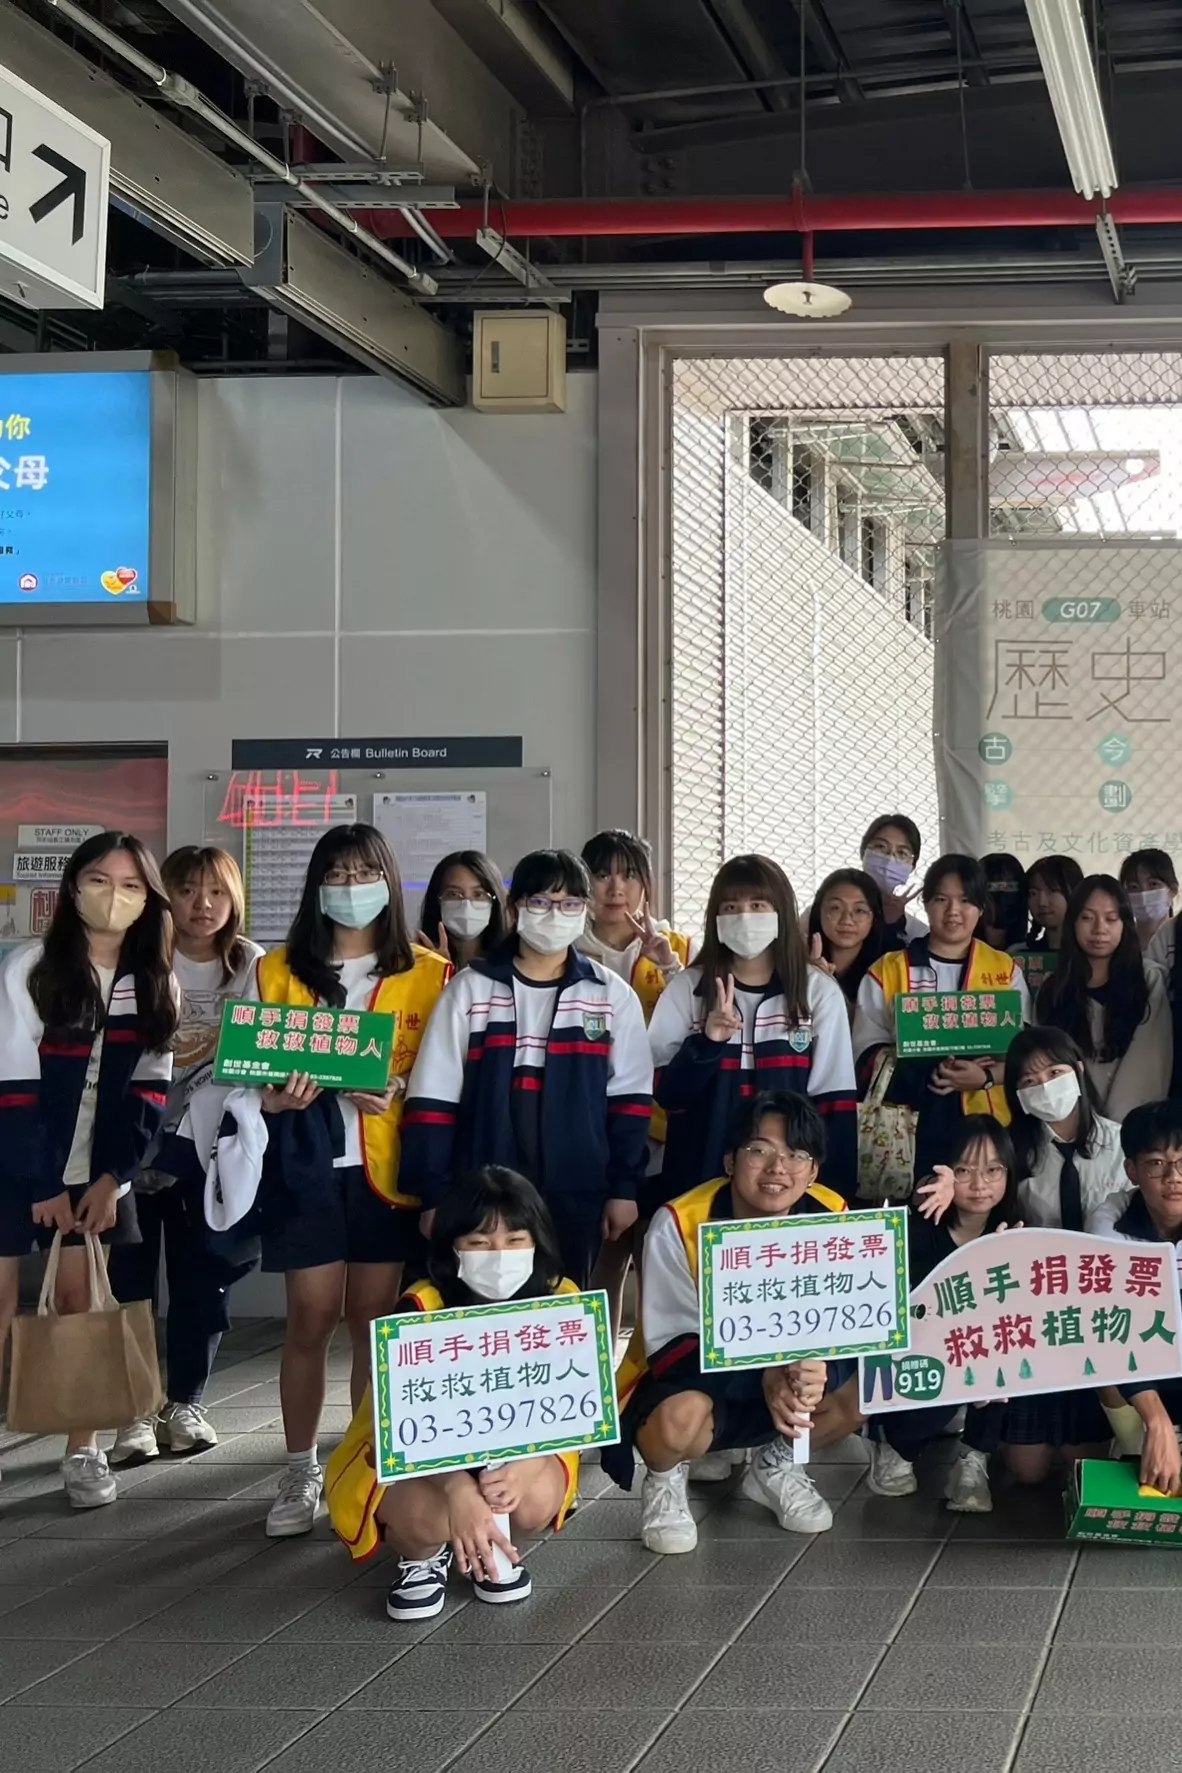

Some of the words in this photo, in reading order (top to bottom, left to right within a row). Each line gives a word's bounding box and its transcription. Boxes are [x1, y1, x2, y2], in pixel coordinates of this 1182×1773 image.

[991, 600, 1035, 620] 桃園
[1059, 602, 1101, 618] G07
[1128, 600, 1171, 620] 車站
[330, 748, 361, 760] 公告欄
[365, 747, 409, 759] Bulletin
[412, 746, 448, 759] Board
[34, 828, 62, 837] STAFF
[64, 828, 89, 837] ONLY
[902, 993, 996, 1013] 順手捐發票
[231, 1004, 360, 1035] 順手捐發票
[923, 1010, 1016, 1030] 救救植物人
[256, 1028, 383, 1060] 救救植物人
[719, 1233, 889, 1271] 順手捐發票
[722, 1270, 888, 1306] 救救植物人
[933, 1254, 1163, 1318] 順手捐發票
[718, 1300, 893, 1343] 03-3397826
[944, 1305, 1177, 1368] 救救植物人
[398, 1318, 588, 1367] 順手捐發票
[902, 1358, 929, 1370] 捐贈碼
[401, 1358, 590, 1405] 救救植物人
[899, 1370, 942, 1394] 919
[398, 1389, 598, 1447] 03-3397826
